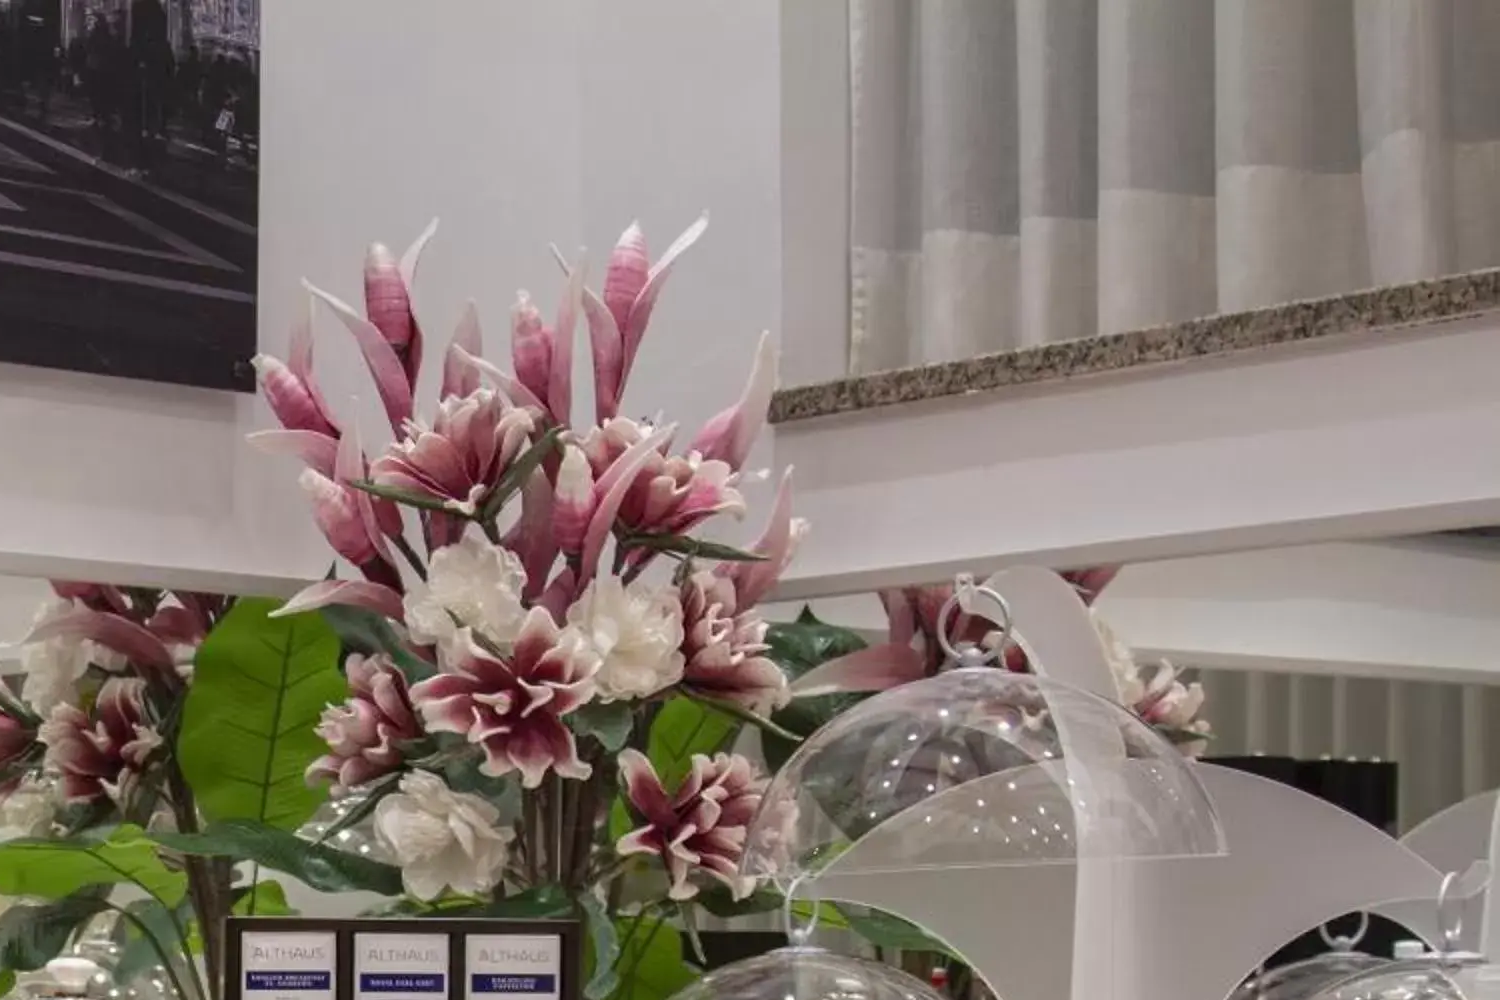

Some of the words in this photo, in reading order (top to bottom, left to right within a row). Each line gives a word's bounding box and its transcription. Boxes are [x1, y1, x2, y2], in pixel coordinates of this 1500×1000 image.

[252, 946, 326, 961] ALTHAUS
[367, 949, 439, 963] ALTHAUS
[478, 949, 550, 964] ALTHAUS
